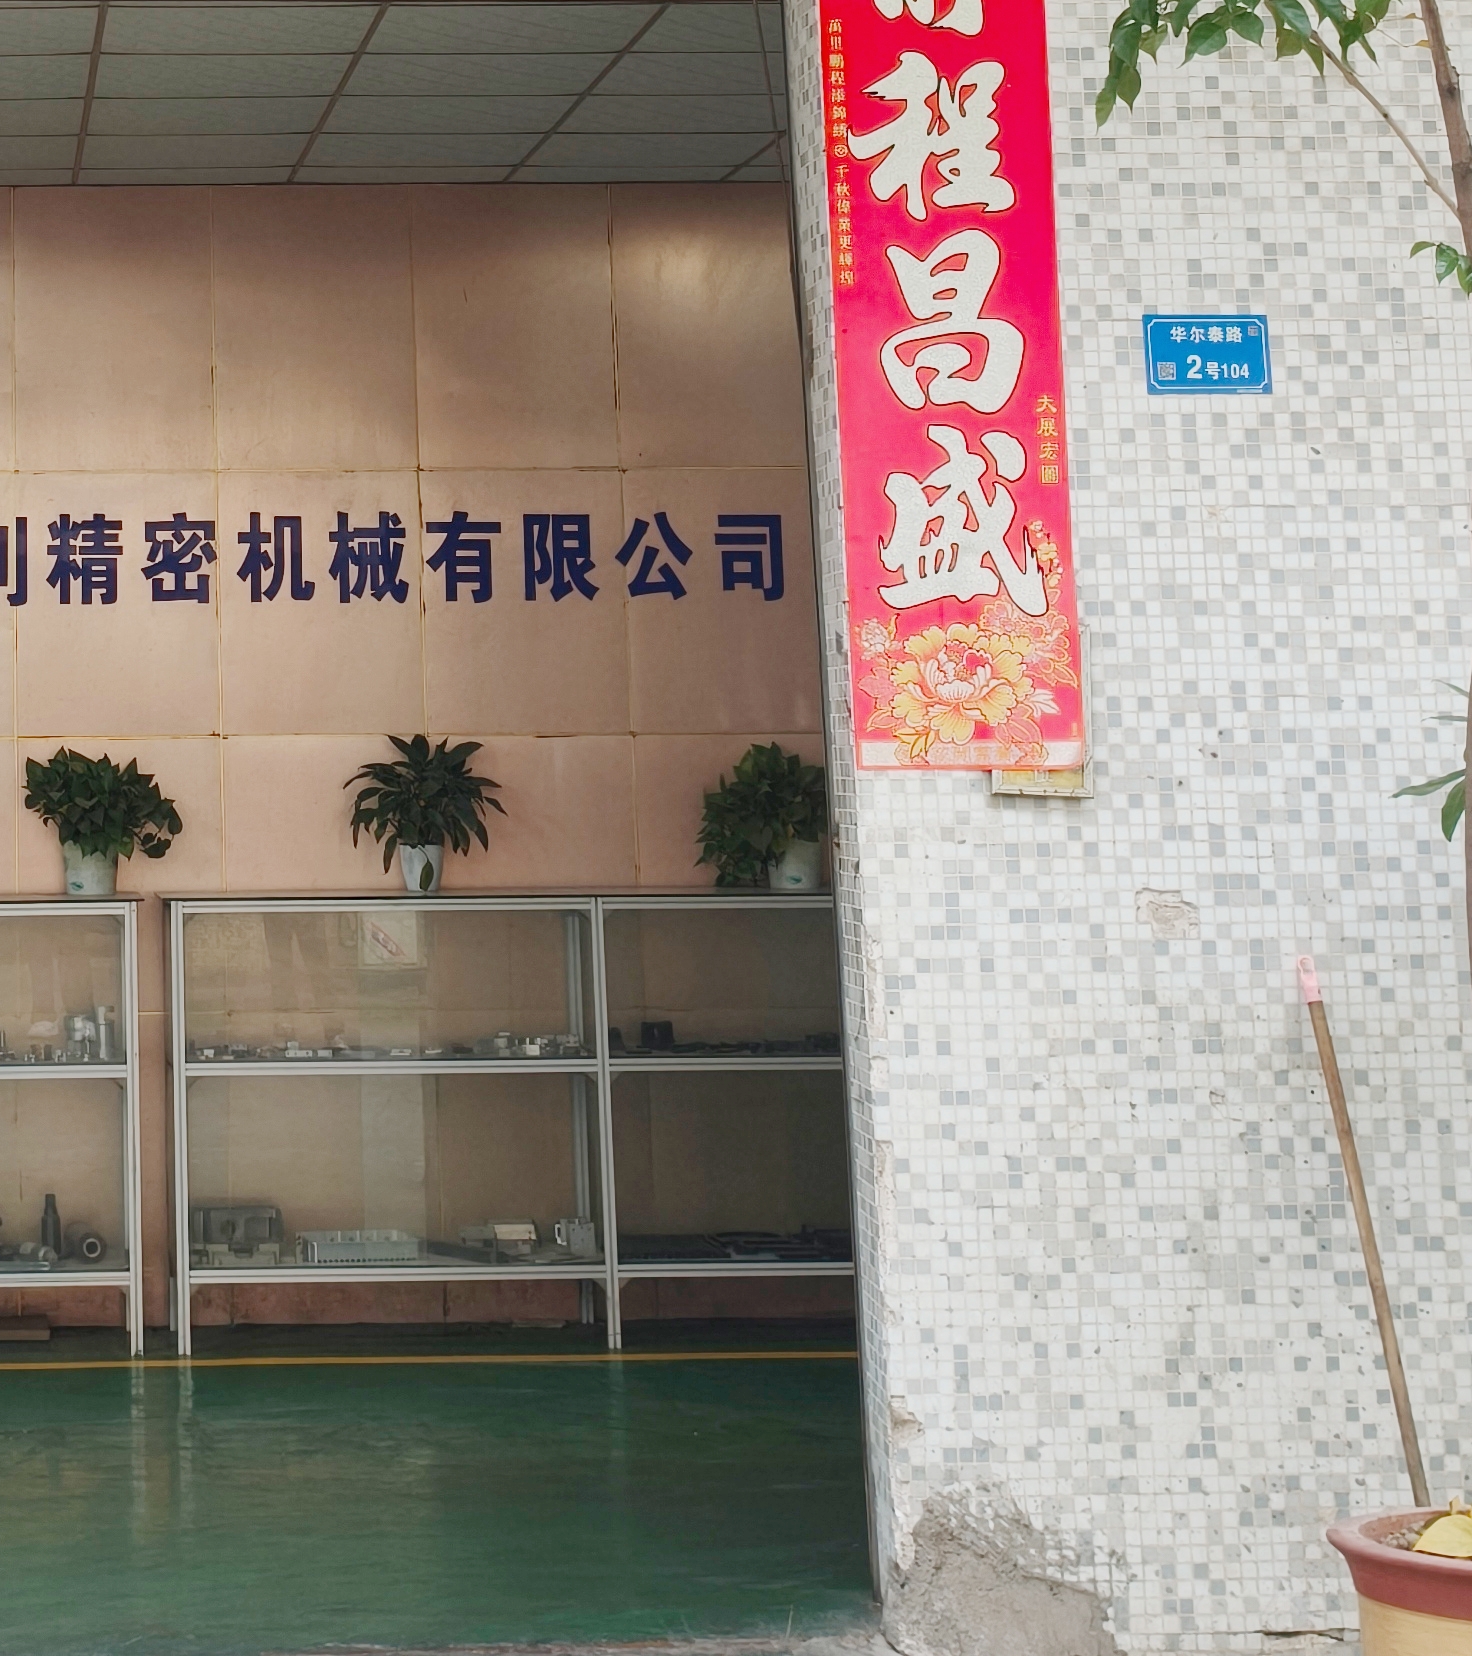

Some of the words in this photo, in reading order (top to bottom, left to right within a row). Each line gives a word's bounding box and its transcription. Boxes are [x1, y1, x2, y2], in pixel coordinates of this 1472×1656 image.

[1170, 326, 1243, 343] 华尔泰路
[1186, 354, 1249, 380] 2号104
